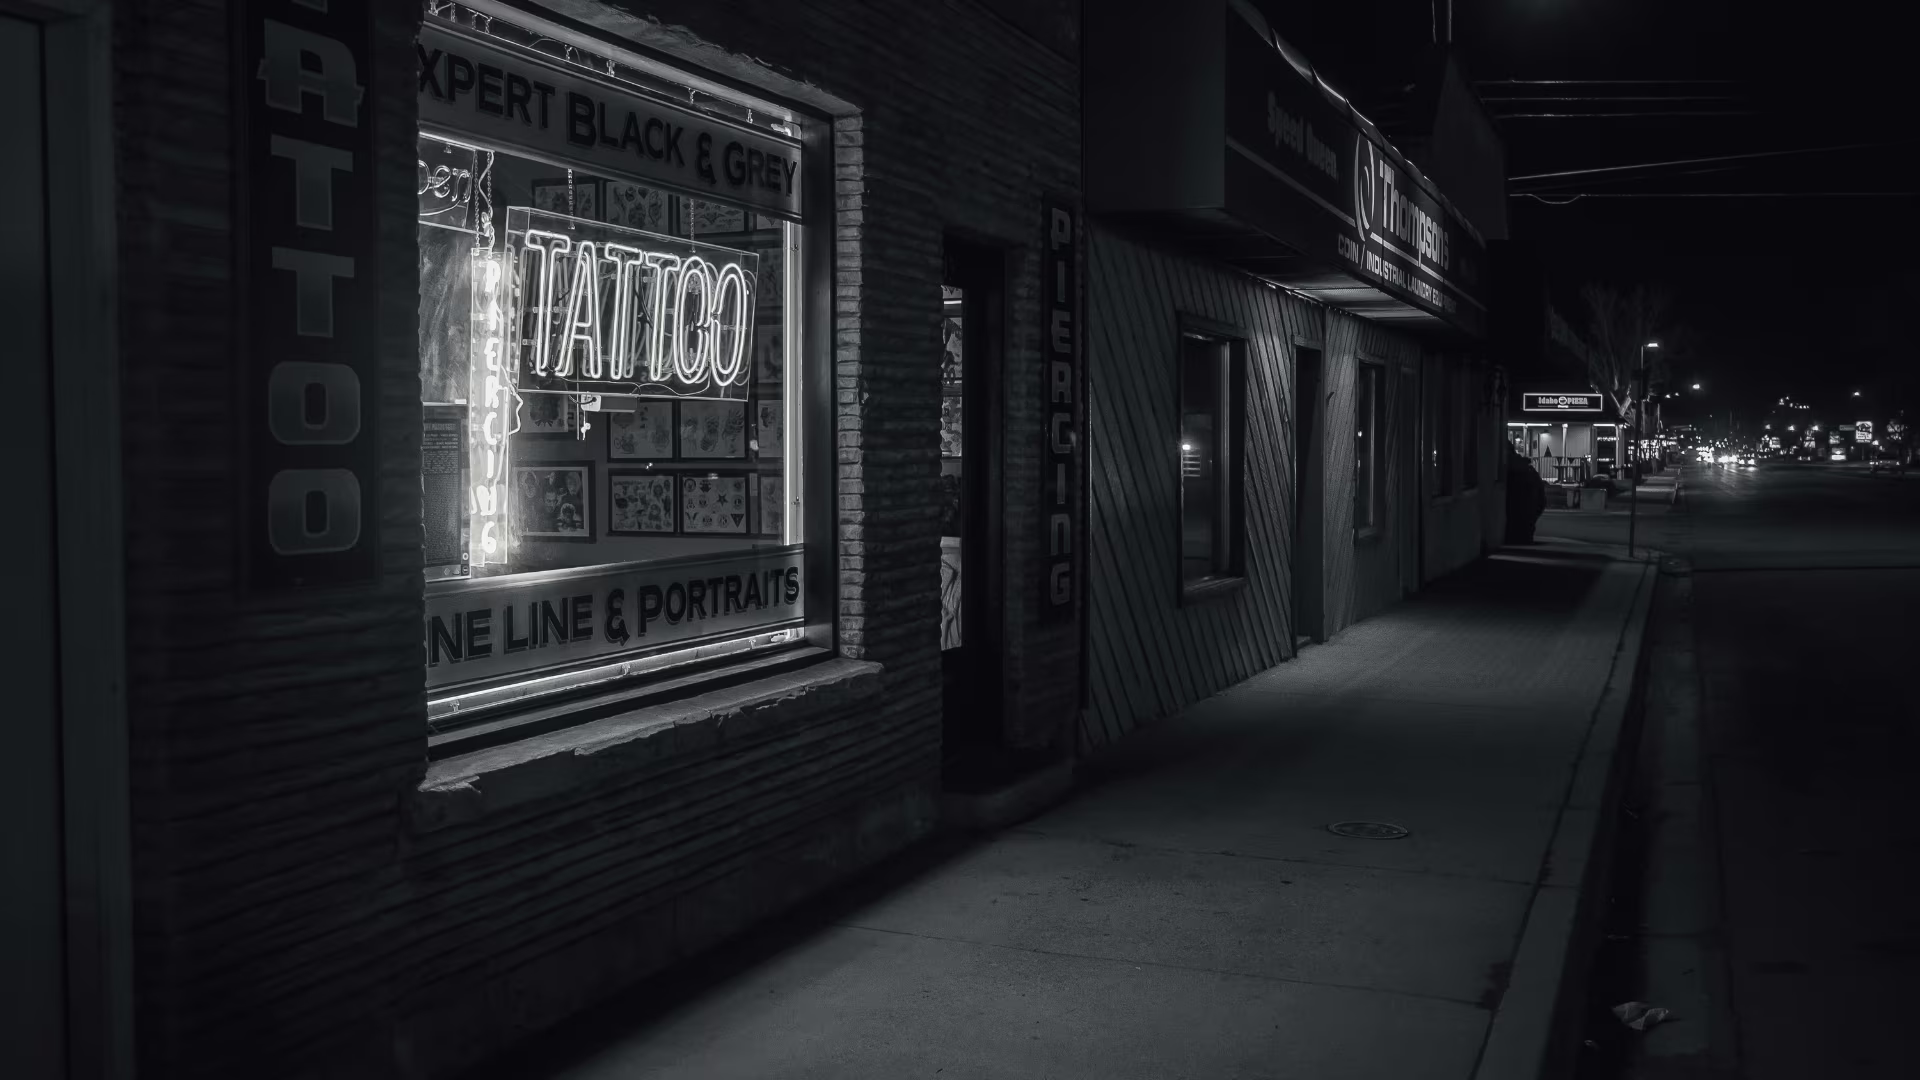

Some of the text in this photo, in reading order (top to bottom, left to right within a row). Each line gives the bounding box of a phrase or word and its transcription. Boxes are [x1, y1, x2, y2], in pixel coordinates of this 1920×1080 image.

[567, 91, 686, 169] BLACK
[694, 131, 717, 186] &
[723, 141, 799, 196] GREY
[256, 0, 365, 556] ATTOO
[525, 228, 749, 387] TATTOO
[1338, 232, 1359, 264] COIN
[1366, 250, 1406, 289] INDUSTRIAL
[504, 594, 594, 653] LINE
[605, 588, 630, 646] &
[638, 566, 800, 638] PORTRAITS
